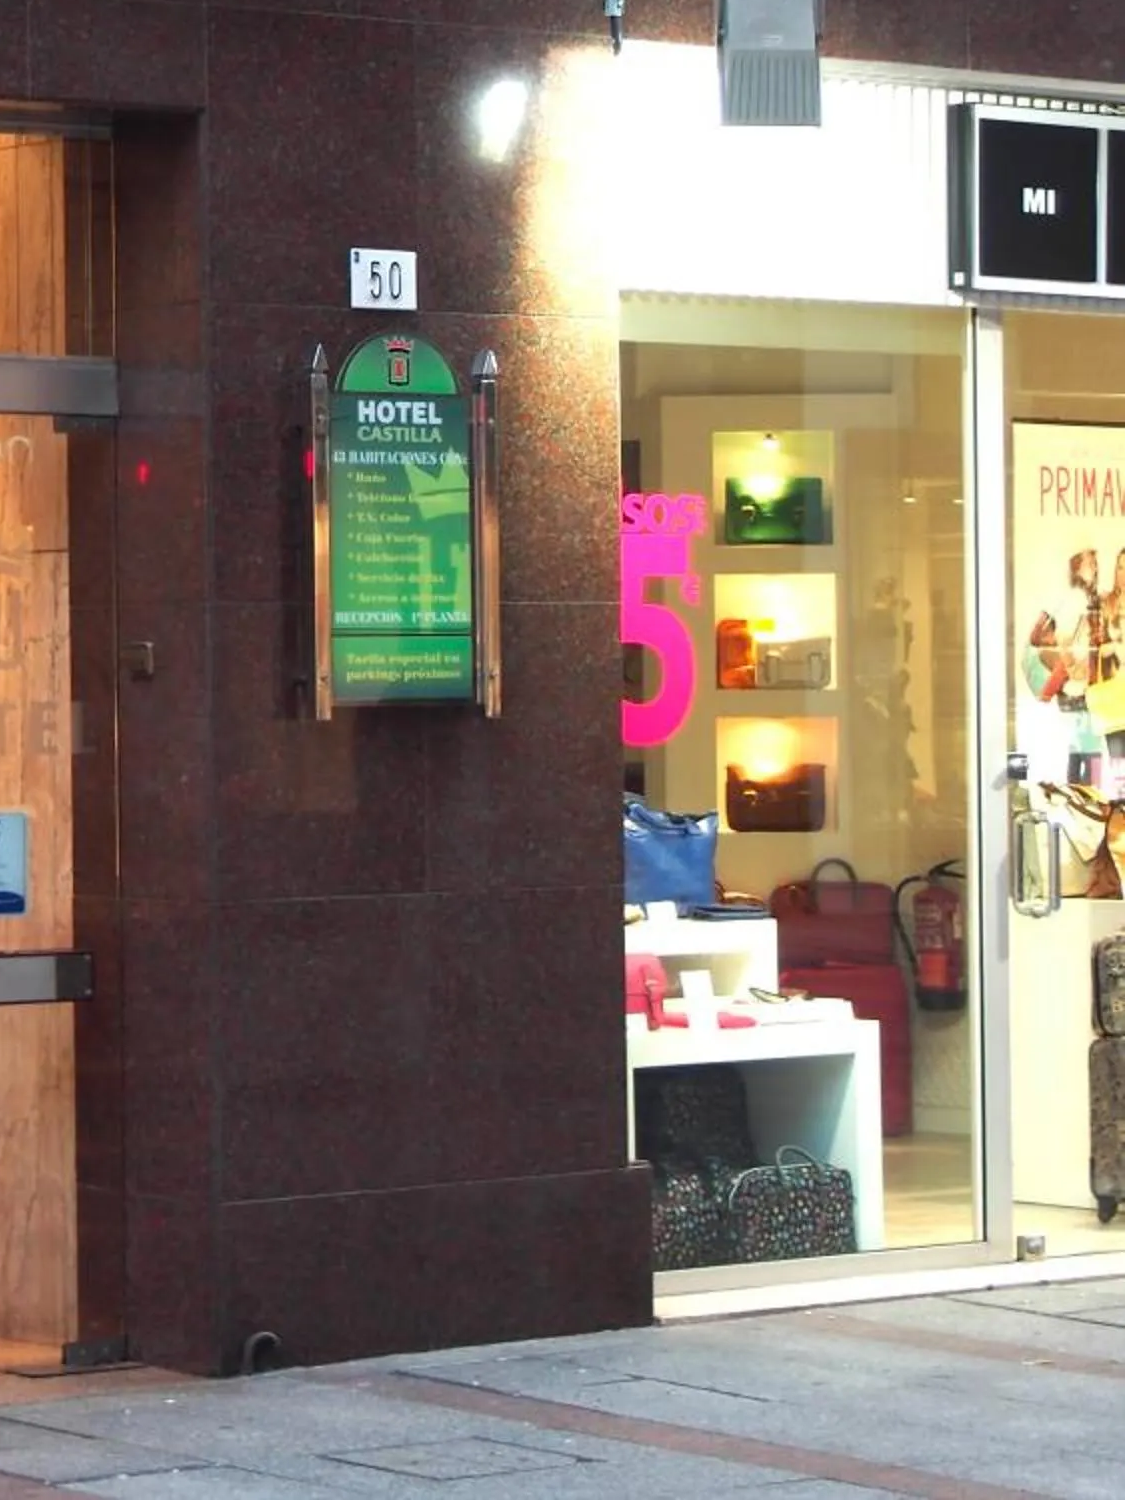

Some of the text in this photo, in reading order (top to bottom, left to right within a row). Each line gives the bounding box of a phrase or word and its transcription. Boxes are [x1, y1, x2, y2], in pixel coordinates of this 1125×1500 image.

[1023, 187, 1056, 215] MI
[370, 260, 402, 300] 50
[357, 399, 443, 425] HOTEL
[356, 425, 443, 444] CASTILLA
